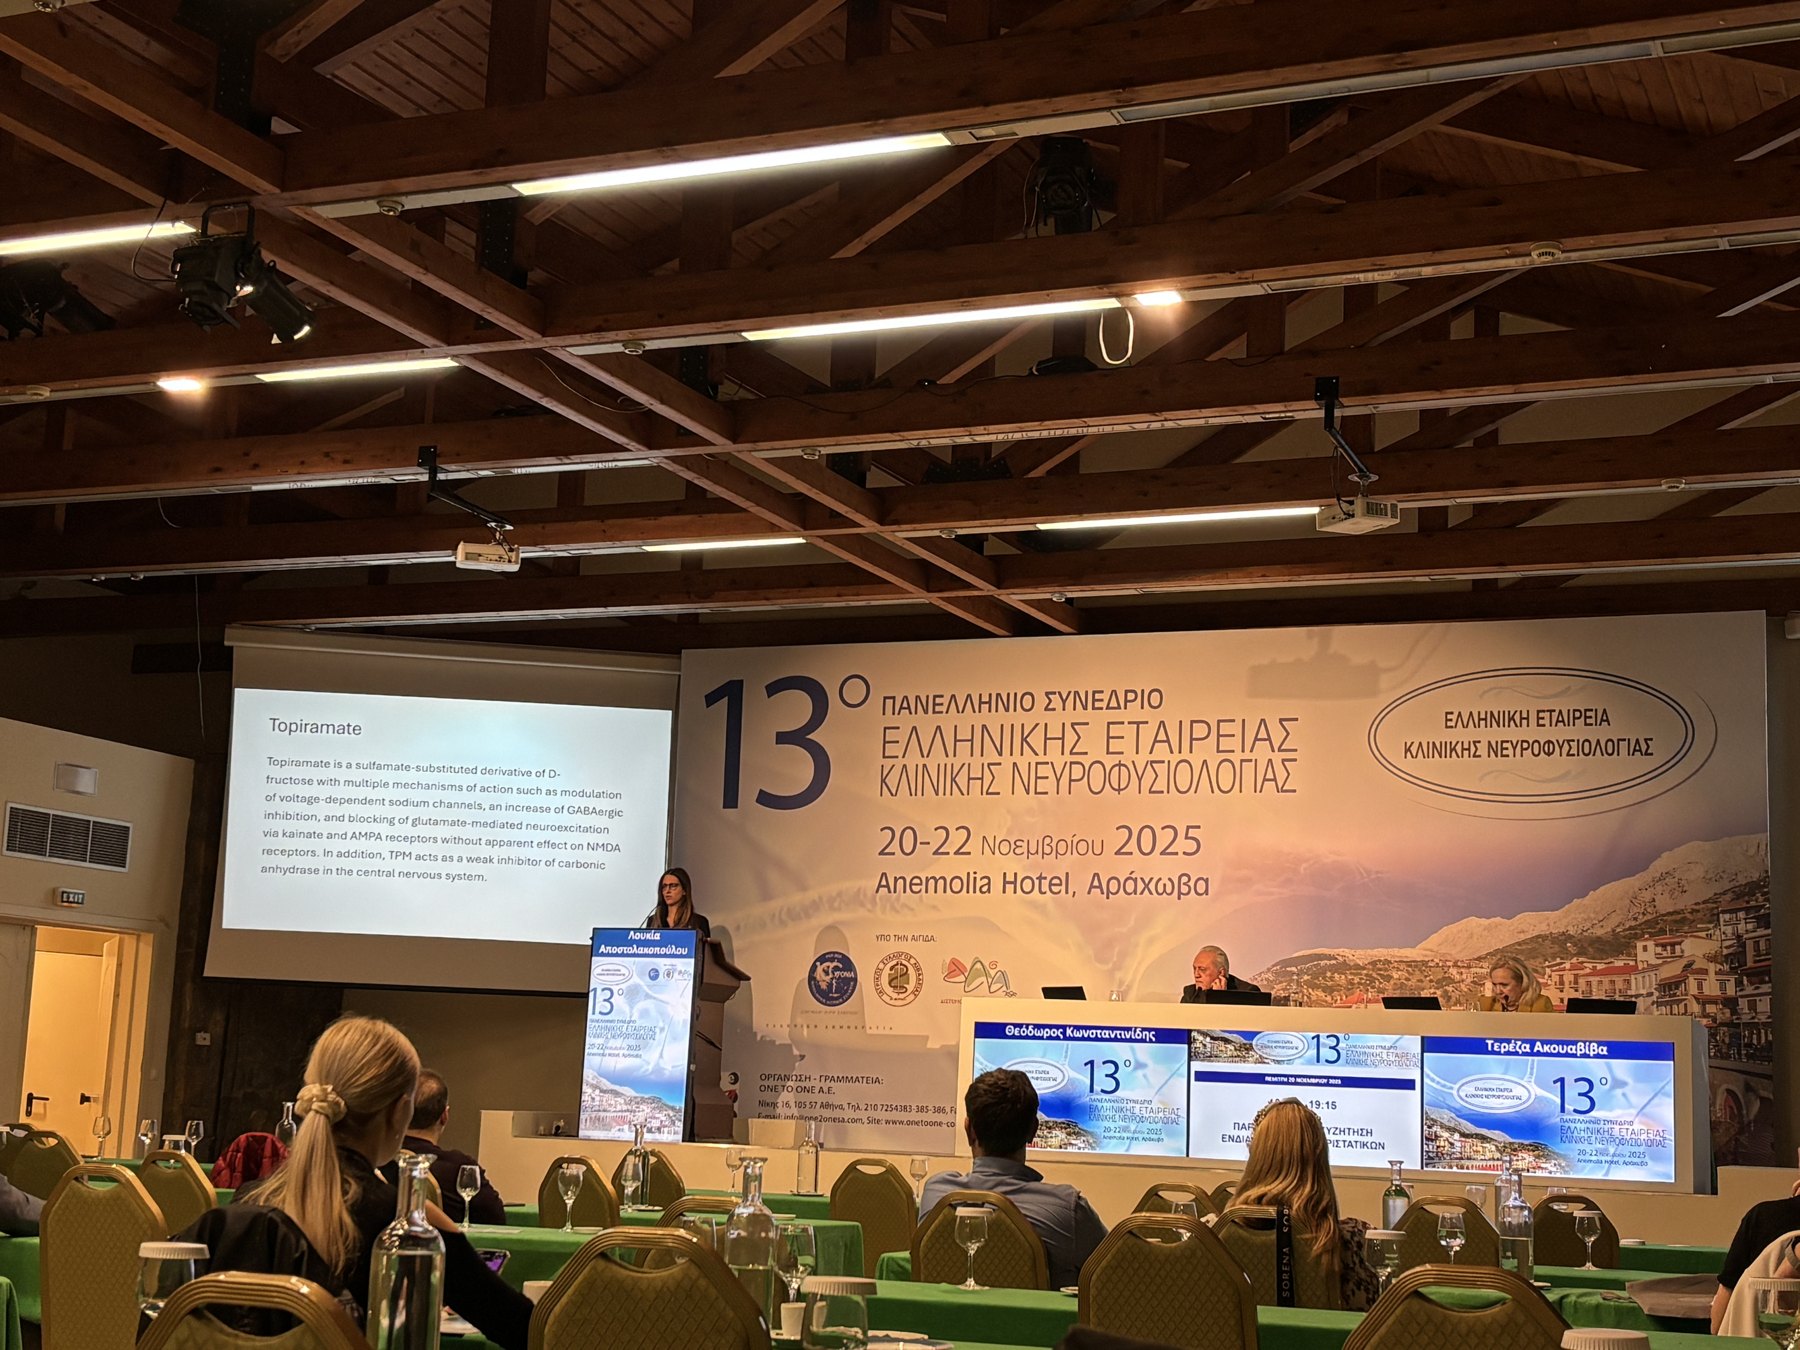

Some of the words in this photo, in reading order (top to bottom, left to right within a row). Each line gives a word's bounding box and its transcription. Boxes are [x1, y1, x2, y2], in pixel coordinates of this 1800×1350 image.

[882, 691, 1035, 716] ΠΑΝΕΛΛΗΝΙΟ
[1043, 687, 1163, 712] ΣΥΝΕΔΡΙΟ
[268, 717, 362, 736] Topiramate
[1444, 709, 1530, 729] ΕΛΛΗΝΙΚΗ
[1536, 707, 1611, 727] ΕΤΑΙΡΕΙΑ
[882, 721, 1090, 759] ΕΛΛΗΝΙΚΗΣ
[1105, 717, 1299, 755] ΕΤΑΙΡΕΙΑΣ
[1404, 739, 1482, 759] ΚΛΙΝΙΚΗΣ
[1487, 737, 1654, 758] ΝΕΥΡΟΦΥΣΙΟΛΟΓΙΑΣ
[266, 756, 331, 769] Topiramate
[333, 759, 343, 769] is
[345, 761, 352, 770] a
[355, 760, 478, 775] sulfamate-substituted
[480, 766, 532, 778] derivative
[534, 768, 546, 778] of
[548, 768, 561, 779] D-
[879, 762, 1002, 797] ΚΛΙΝΙΚΗΣ
[1011, 757, 1298, 795] ΝΕΥΡΟΦΥΣΙΟΛΟΓΙΑΣ
[265, 774, 314, 786] fructose
[316, 776, 340, 787] with
[343, 778, 390, 790] multiple
[392, 780, 463, 792] mechanisms
[465, 783, 477, 792] of
[479, 784, 514, 794] action
[516, 785, 542, 796] such
[544, 788, 558, 796] as
[560, 788, 622, 800] modulation
[264, 792, 277, 802] of
[278, 793, 386, 806] voltage-dependent
[388, 797, 430, 808] sodium
[432, 799, 486, 812] channels,
[488, 803, 502, 811] an
[504, 802, 552, 814] increase
[553, 804, 565, 814] of
[566, 805, 624, 820] GABAergic
[263, 810, 320, 823] inhibition,
[323, 813, 345, 822] and
[347, 813, 396, 827] blocking
[397, 815, 410, 825] of
[410, 815, 523, 830] glutamate-mediated
[525, 823, 610, 834] neuroexcitation
[262, 828, 279, 838] via
[281, 828, 323, 839] kainate
[326, 831, 347, 840] and
[349, 831, 383, 842] AMPA
[385, 834, 438, 845] receptors
[440, 835, 482, 846] without
[484, 838, 534, 849] apparent
[536, 839, 568, 850] effect
[569, 842, 584, 851] on
[586, 841, 621, 853] NMDA
[877, 825, 971, 856] 20-22
[981, 833, 1104, 860] Νοεμβρίου
[1113, 824, 1201, 856] 2025
[261, 848, 320, 858] receptors.
[323, 848, 333, 858] In
[335, 848, 385, 861] addition,
[388, 850, 412, 860] TPM
[414, 853, 439, 862] acts
[440, 854, 454, 863] as
[456, 855, 463, 863] a
[465, 854, 495, 864] weak
[497, 855, 542, 867] inhibitor
[544, 857, 556, 867] of
[557, 859, 606, 870] carbonic
[260, 864, 320, 876] anhydrase
[322, 865, 333, 875] in
[335, 866, 354, 876] the
[356, 868, 395, 878] central
[397, 870, 442, 880] nervous
[444, 872, 487, 883] system.
[874, 870, 991, 894] Anemolia
[1002, 871, 1076, 898] Hotel,
[1086, 870, 1209, 901] Αράχωβα
[63, 893, 83, 902] EXIT
[628, 930, 661, 941] Λουκία
[875, 934, 891, 942] ΥΠΟ
[893, 934, 908, 942] ΤΗΝ
[910, 934, 936, 942] ΑΙΓΙΔΑ:
[598, 944, 689, 955] Αποστολακοπούλου
[1005, 1025, 1063, 1038] Θεόδωρος
[1066, 1027, 1156, 1041] Κωνσταντινίδης
[1486, 1040, 1531, 1055] Τερέζα
[1533, 1040, 1608, 1057] Ακουαβίβα
[759, 1072, 811, 1083] ΟΡΓΑΝΩΣΗ
[818, 1074, 884, 1085] ΓΡΑΜΜΑΤΕΙΑ:
[759, 1084, 779, 1093] ONE
[781, 1085, 794, 1093] TO
[795, 1085, 816, 1094] ONE
[817, 1086, 836, 1095] A.E.
[794, 1100, 807, 1109] 105
[808, 1100, 818, 1109] 57
[819, 1101, 845, 1112] Αθήνα,
[846, 1102, 862, 1112] Τηλ.
[863, 1102, 878, 1112] 210
[1088, 1104, 1136, 1114] ΕΛΛΗΝΙΚΗΣ
[1139, 1106, 1181, 1116] ΕΤΑΙΡΕΙΑΣ
[1309, 1100, 1337, 1110] 19:15
[866, 1115, 883, 1125] Site:
[884, 1118, 956, 1128] www.onetoone-co
[1146, 1127, 1163, 1135] 2025
[1326, 1127, 1373, 1137] ΥΖΗΤΗΣΗ
[1560, 1125, 1615, 1136] ΕΛΛΗΝΙΚΗΣ
[1619, 1127, 1667, 1138] ΕΤΑΙΡΕΙΑΣ
[1327, 1139, 1385, 1150] ΡΙΣΤΑΤΙΚΩΝ
[1628, 1151, 1646, 1159] 2025
[1282, 1247, 1290, 1298] SORENA
